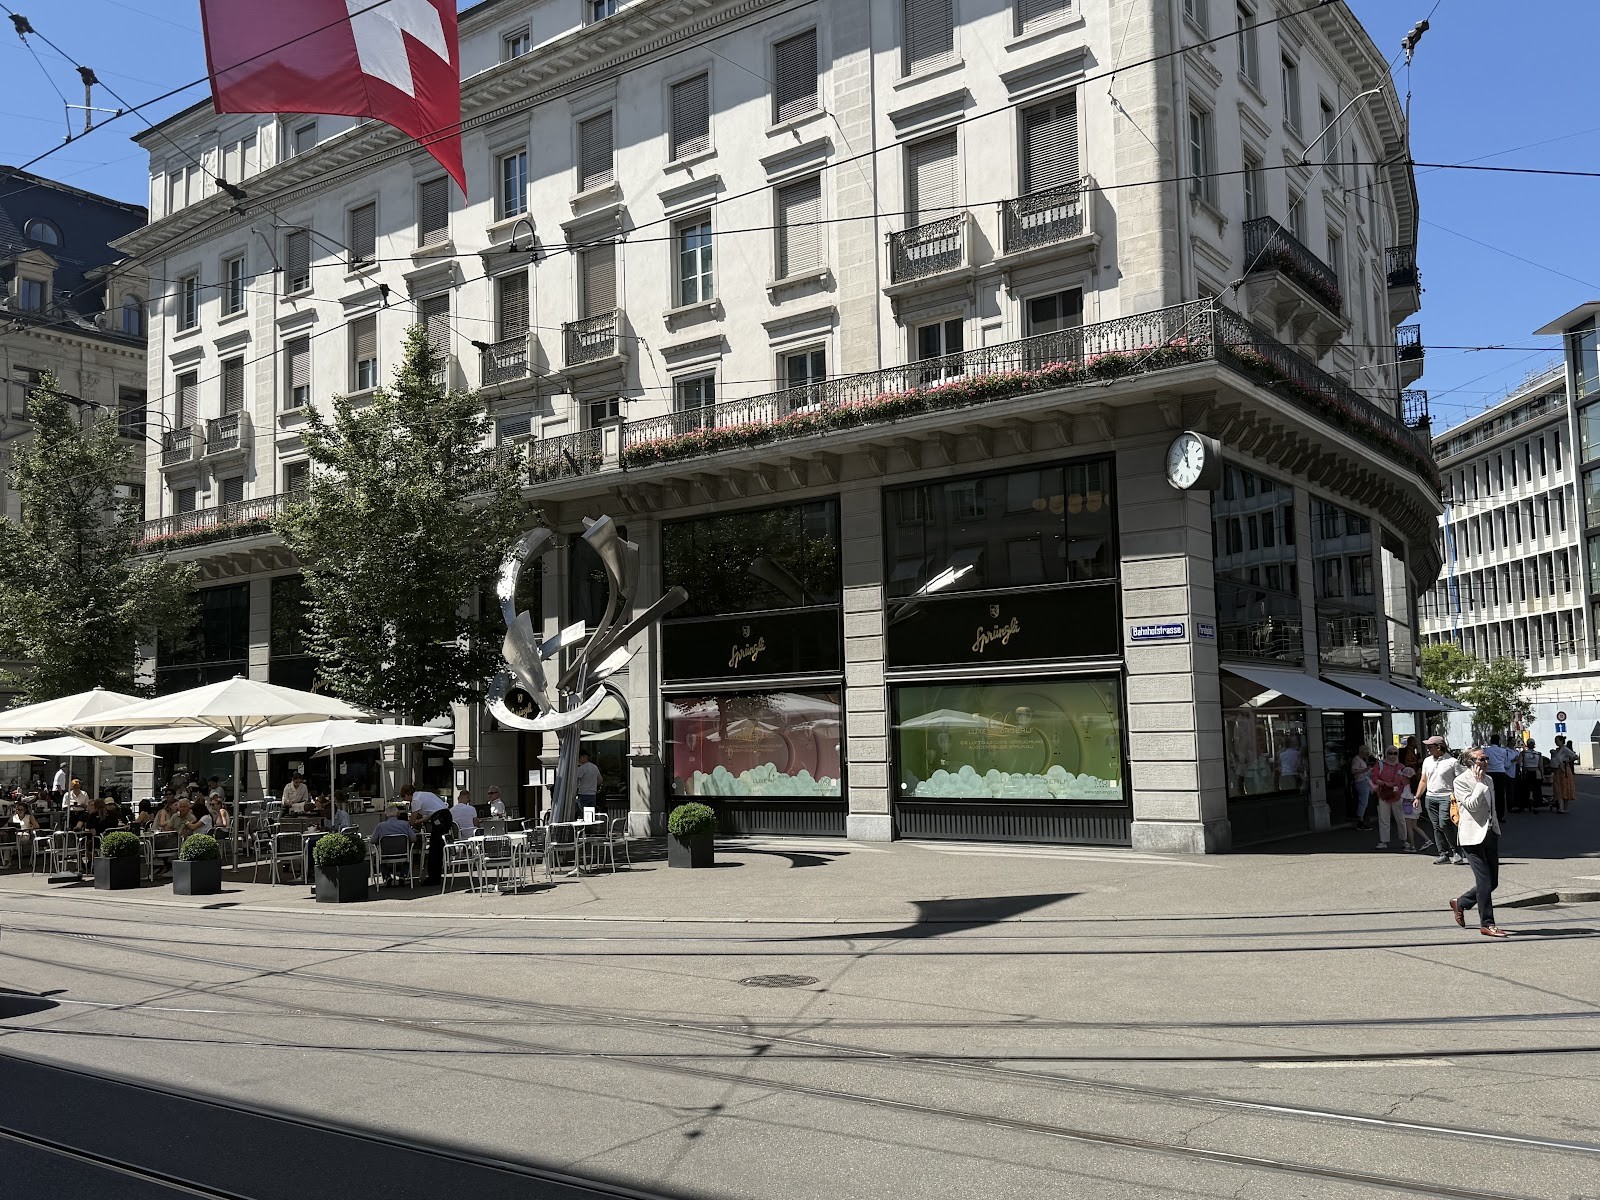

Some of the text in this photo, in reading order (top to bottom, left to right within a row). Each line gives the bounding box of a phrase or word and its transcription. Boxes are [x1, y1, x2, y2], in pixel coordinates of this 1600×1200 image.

[971, 616, 1021, 653] Sprüngli
[1132, 625, 1182, 637] Bahnhofstrasse
[728, 636, 767, 669] Sprüngli
